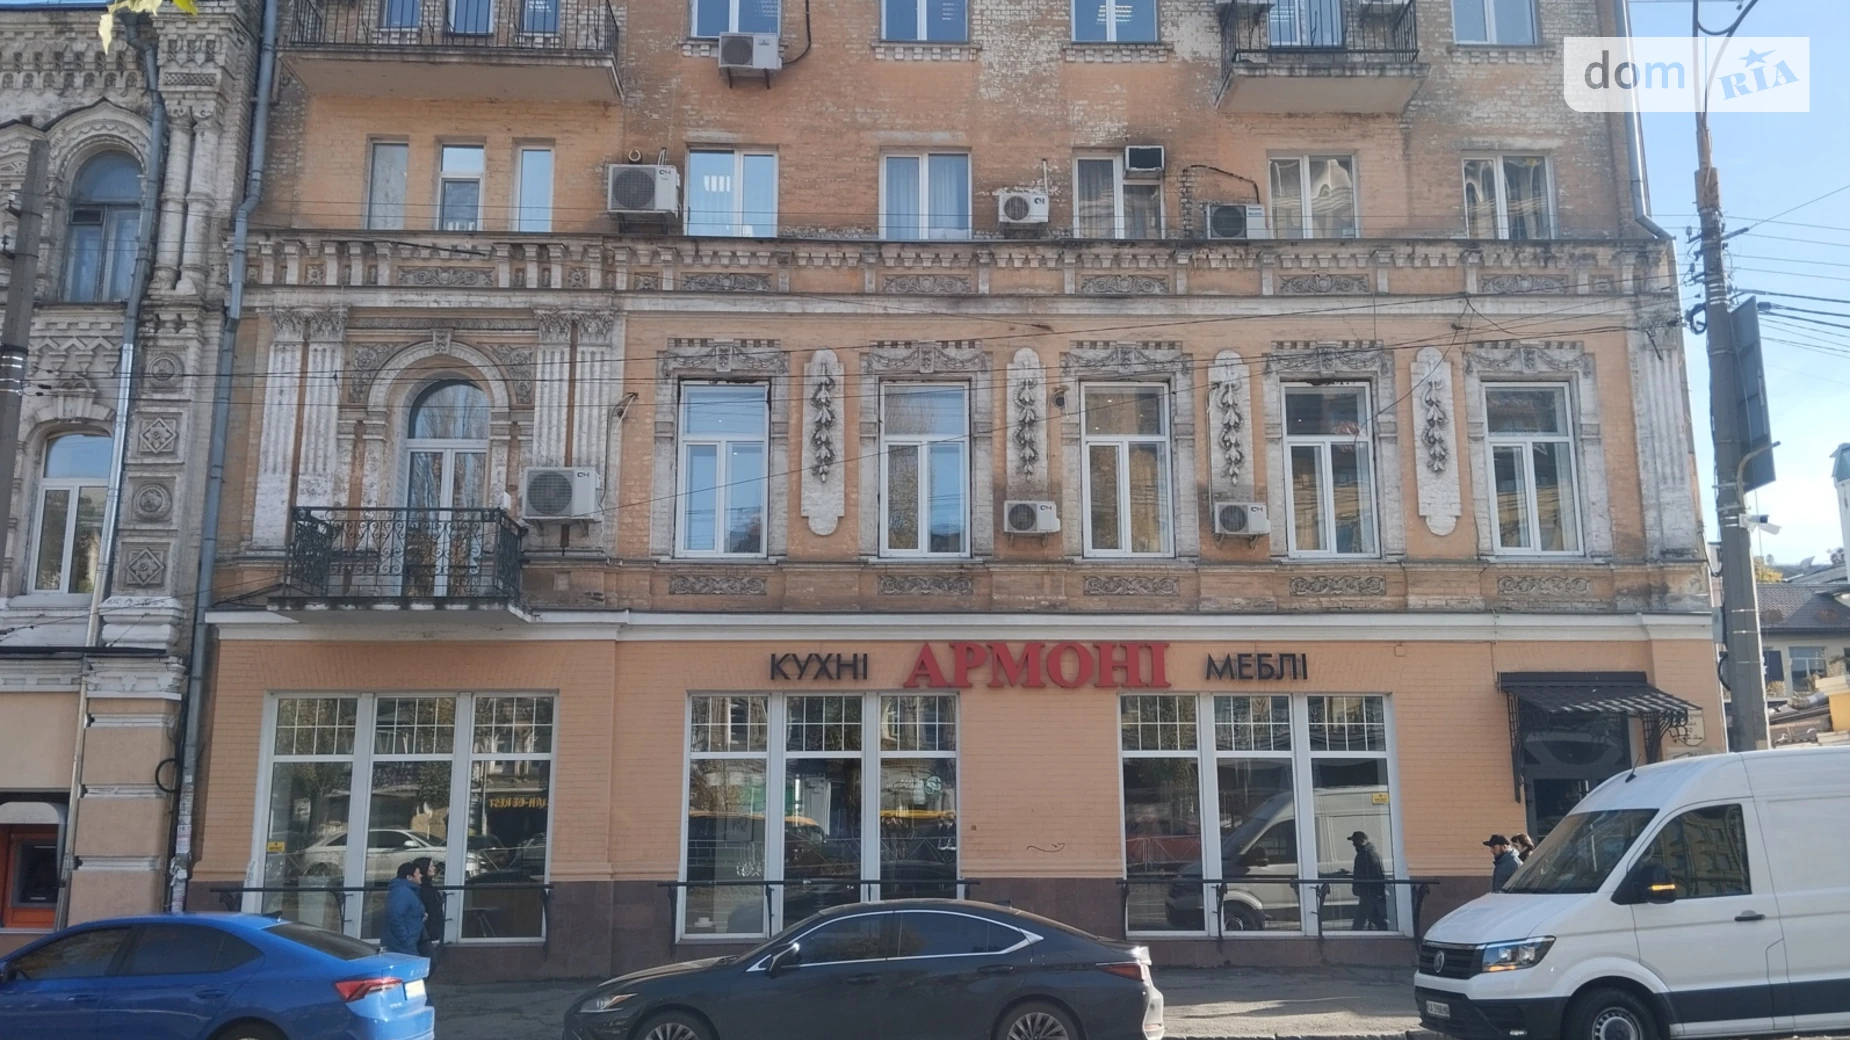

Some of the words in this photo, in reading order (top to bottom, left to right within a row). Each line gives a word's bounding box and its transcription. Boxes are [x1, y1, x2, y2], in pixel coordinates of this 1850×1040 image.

[770, 653, 868, 680] КУХНІ
[903, 642, 1171, 688] АРМОНІ
[1205, 652, 1308, 680] МЕБЛІ
